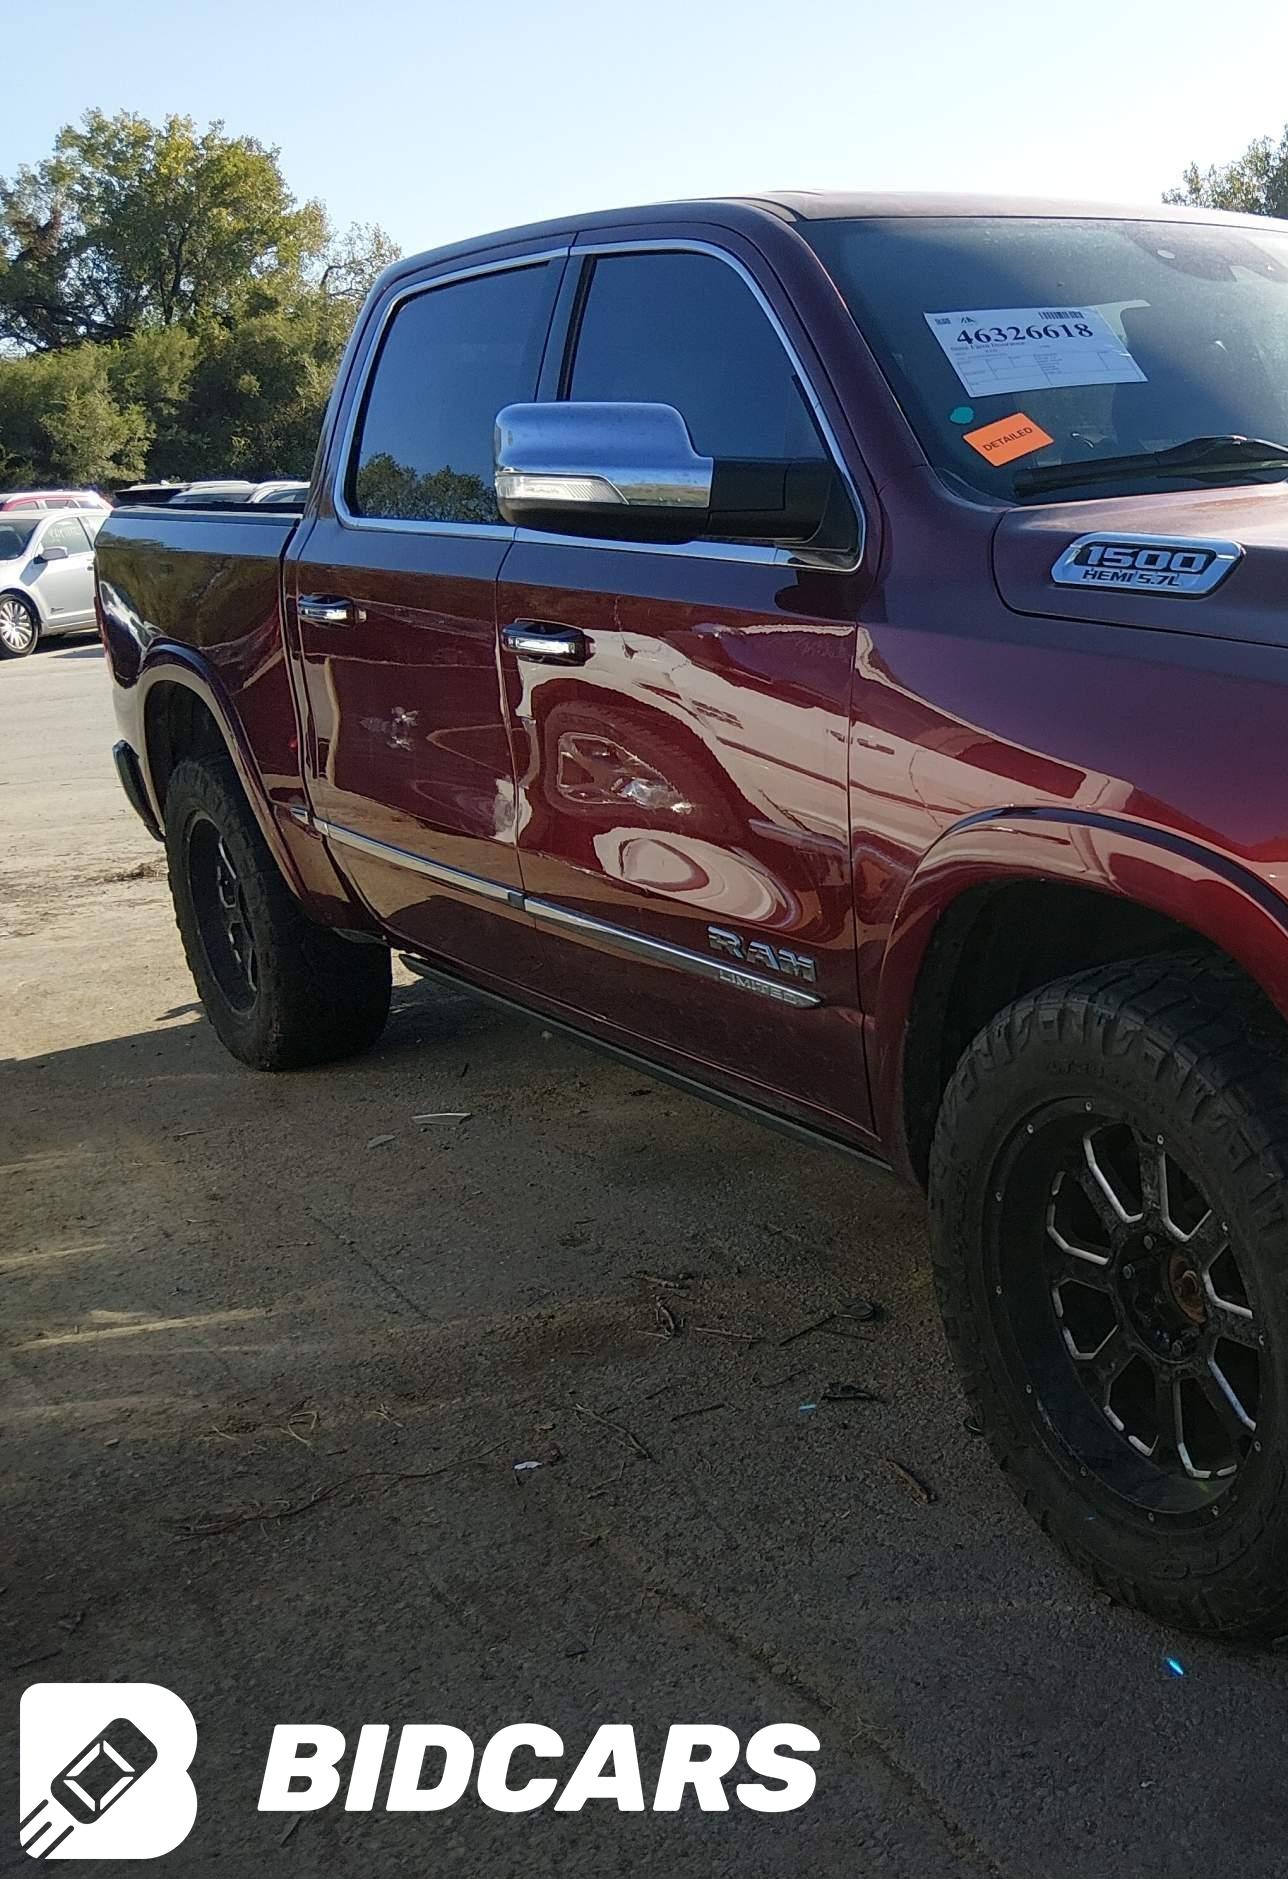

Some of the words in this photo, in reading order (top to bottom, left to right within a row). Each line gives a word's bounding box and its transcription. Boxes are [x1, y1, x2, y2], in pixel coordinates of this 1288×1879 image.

[957, 323, 1094, 345] 46326618
[983, 427, 1033, 451] DETAILED
[1087, 546, 1206, 572] 1500
[1083, 569, 1133, 582] HEMI
[1136, 574, 1180, 586] 5.7L
[707, 926, 816, 982] RAM
